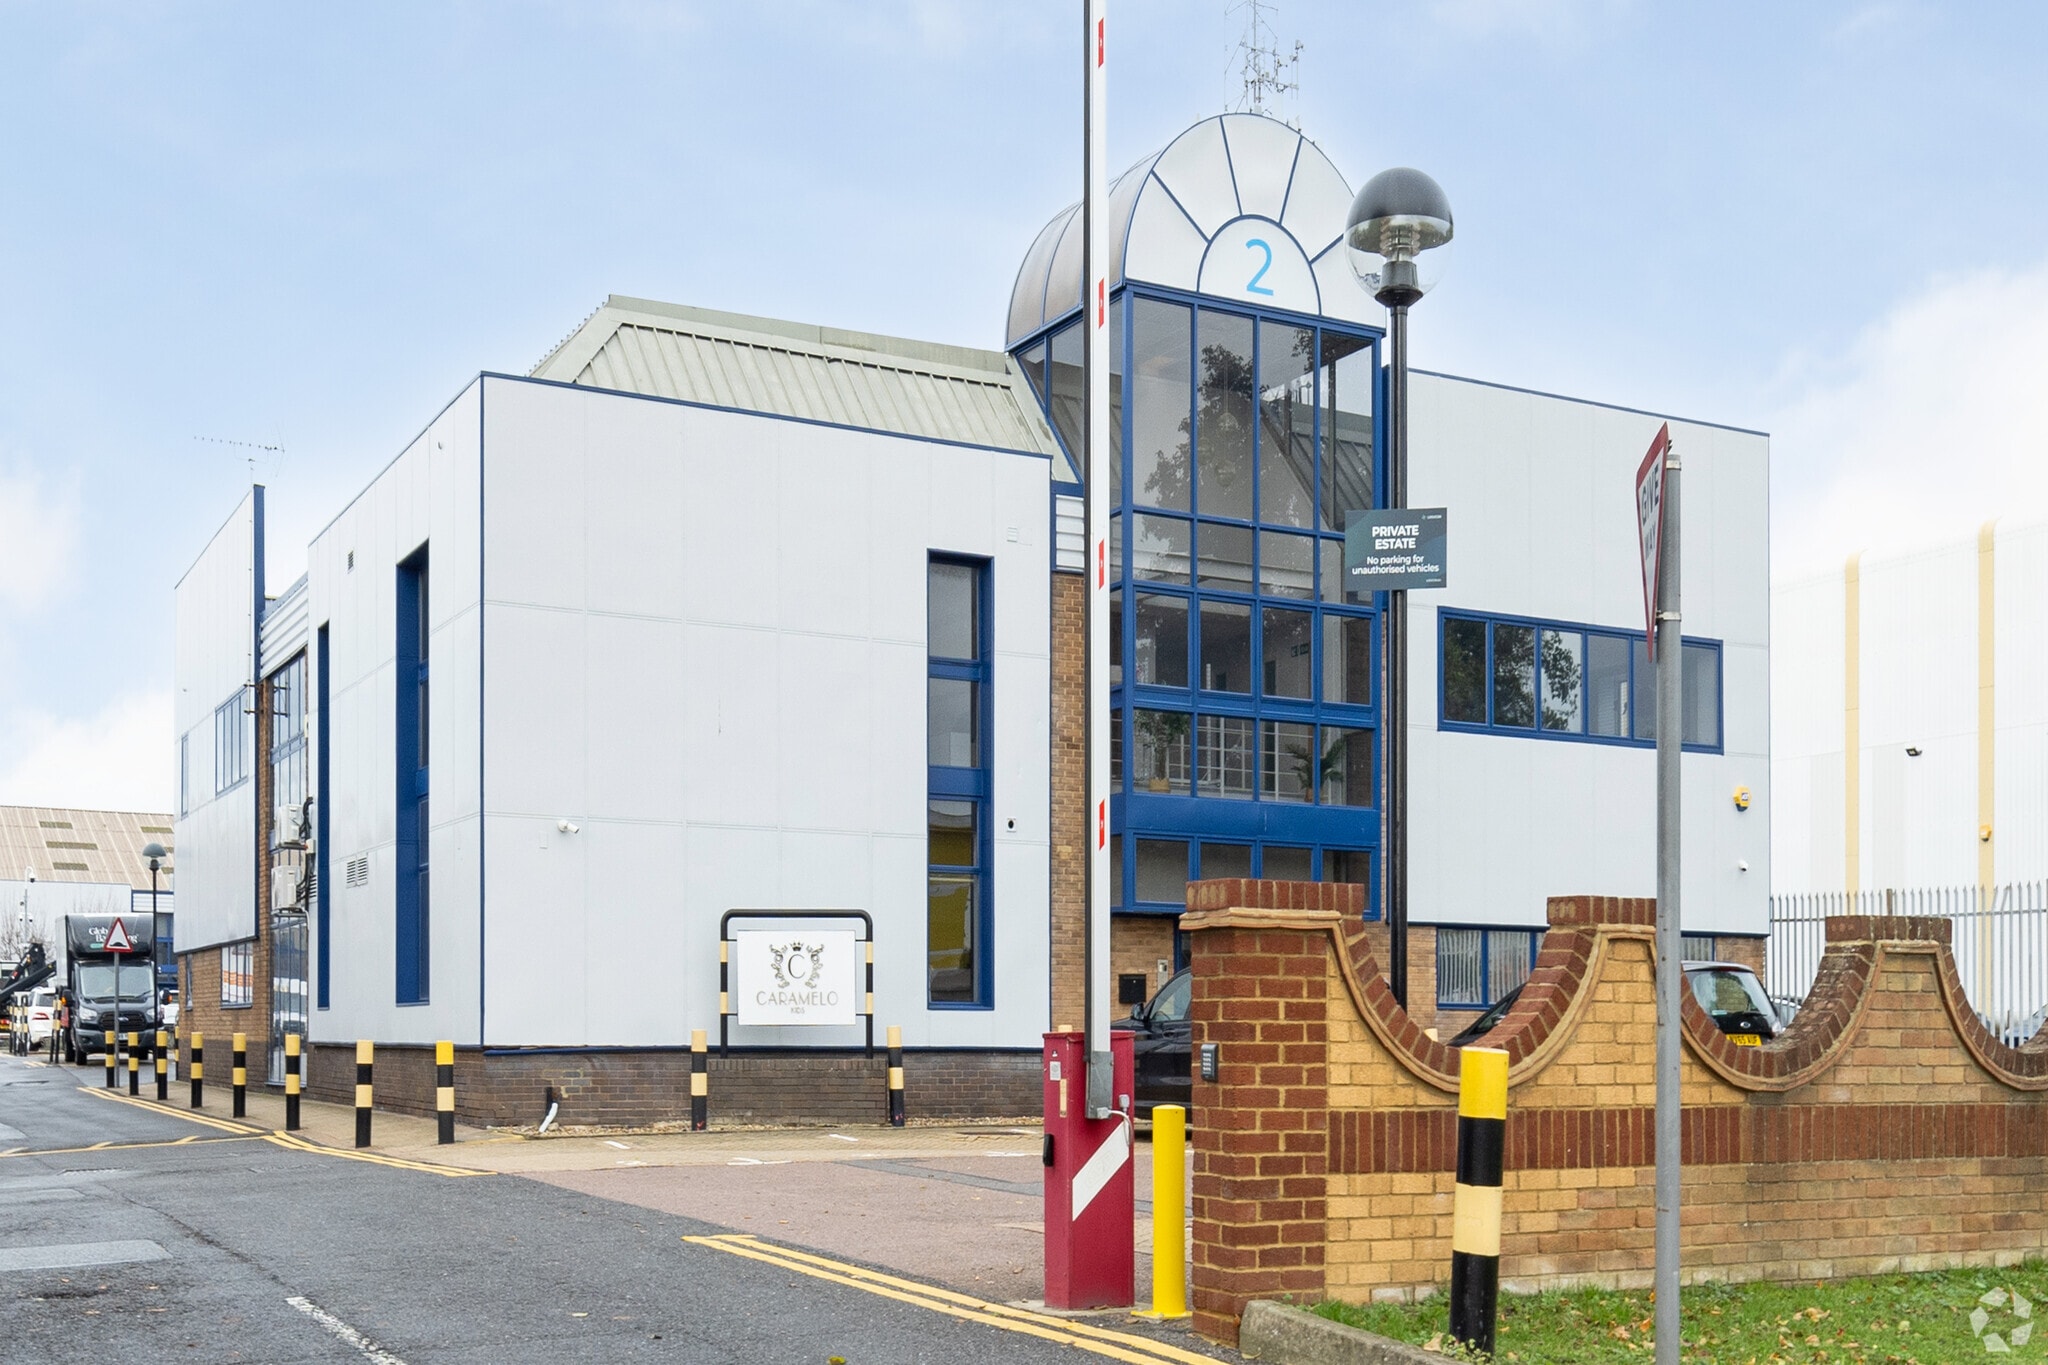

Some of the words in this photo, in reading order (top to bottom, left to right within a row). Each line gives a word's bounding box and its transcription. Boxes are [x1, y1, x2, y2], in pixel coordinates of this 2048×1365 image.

[1245, 238, 1274, 296] 2
[1641, 463, 1660, 527] GIVE
[1371, 525, 1420, 537] PRIVATE
[1375, 538, 1417, 550] ESTATE
[1366, 556, 1379, 565] No
[1380, 555, 1411, 566] parking
[1412, 554, 1424, 563] for
[1352, 565, 1405, 575] unauthorised
[1406, 563, 1440, 573] vehicles
[788, 954, 806, 979] C
[756, 990, 839, 1006] CARAMELO
